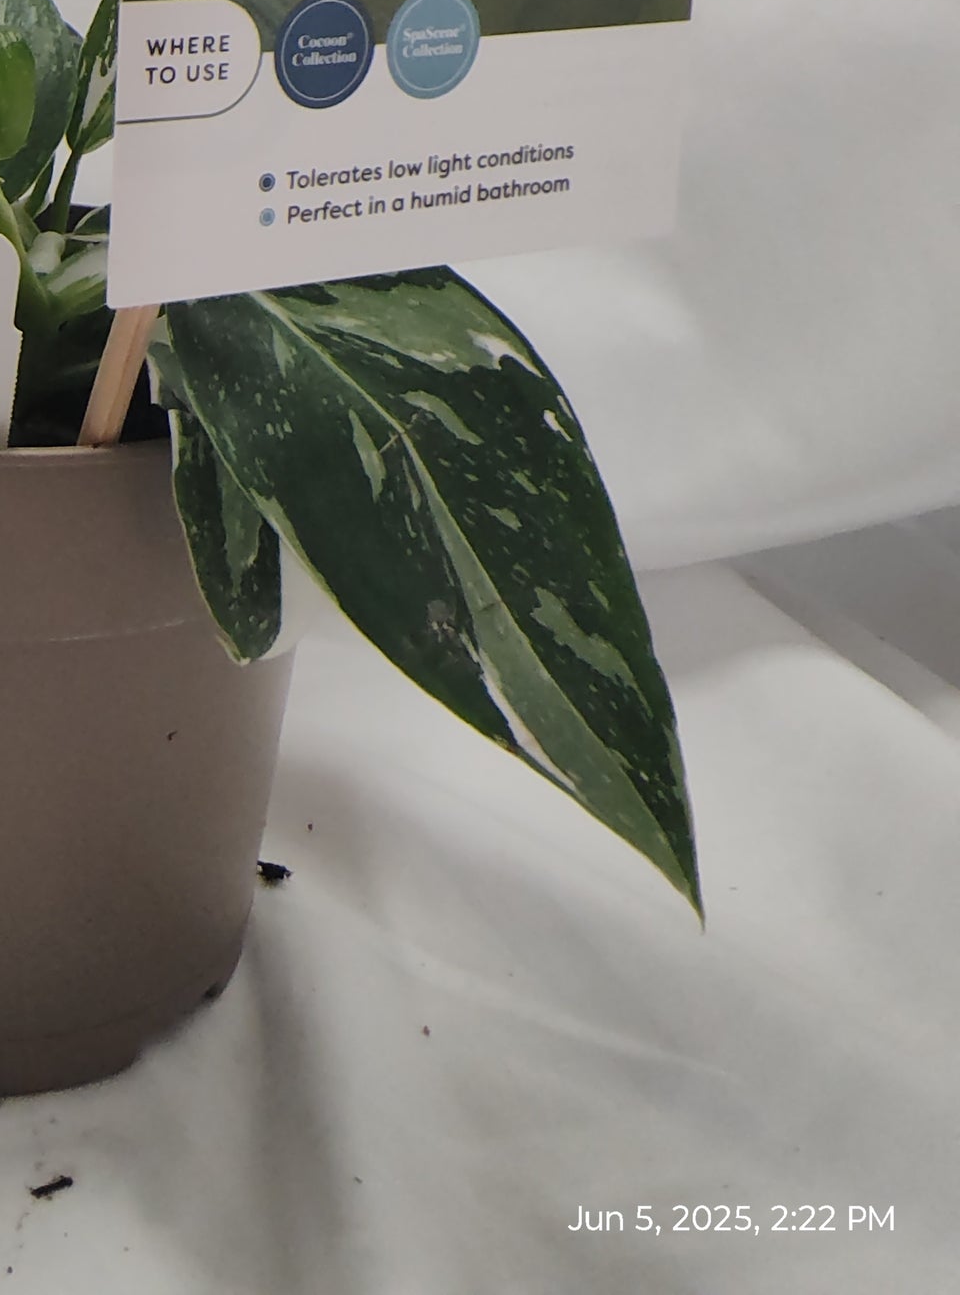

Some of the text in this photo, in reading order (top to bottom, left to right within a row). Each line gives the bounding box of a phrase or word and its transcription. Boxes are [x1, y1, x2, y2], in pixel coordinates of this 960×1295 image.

[146, 35, 231, 57] WHERE
[403, 41, 463, 59] Collection
[292, 50, 357, 67] Collection
[146, 63, 229, 85] TO USE
[286, 143, 575, 190] Tolerates low light conditions
[288, 175, 570, 224] Perfect in a humid bathroom
